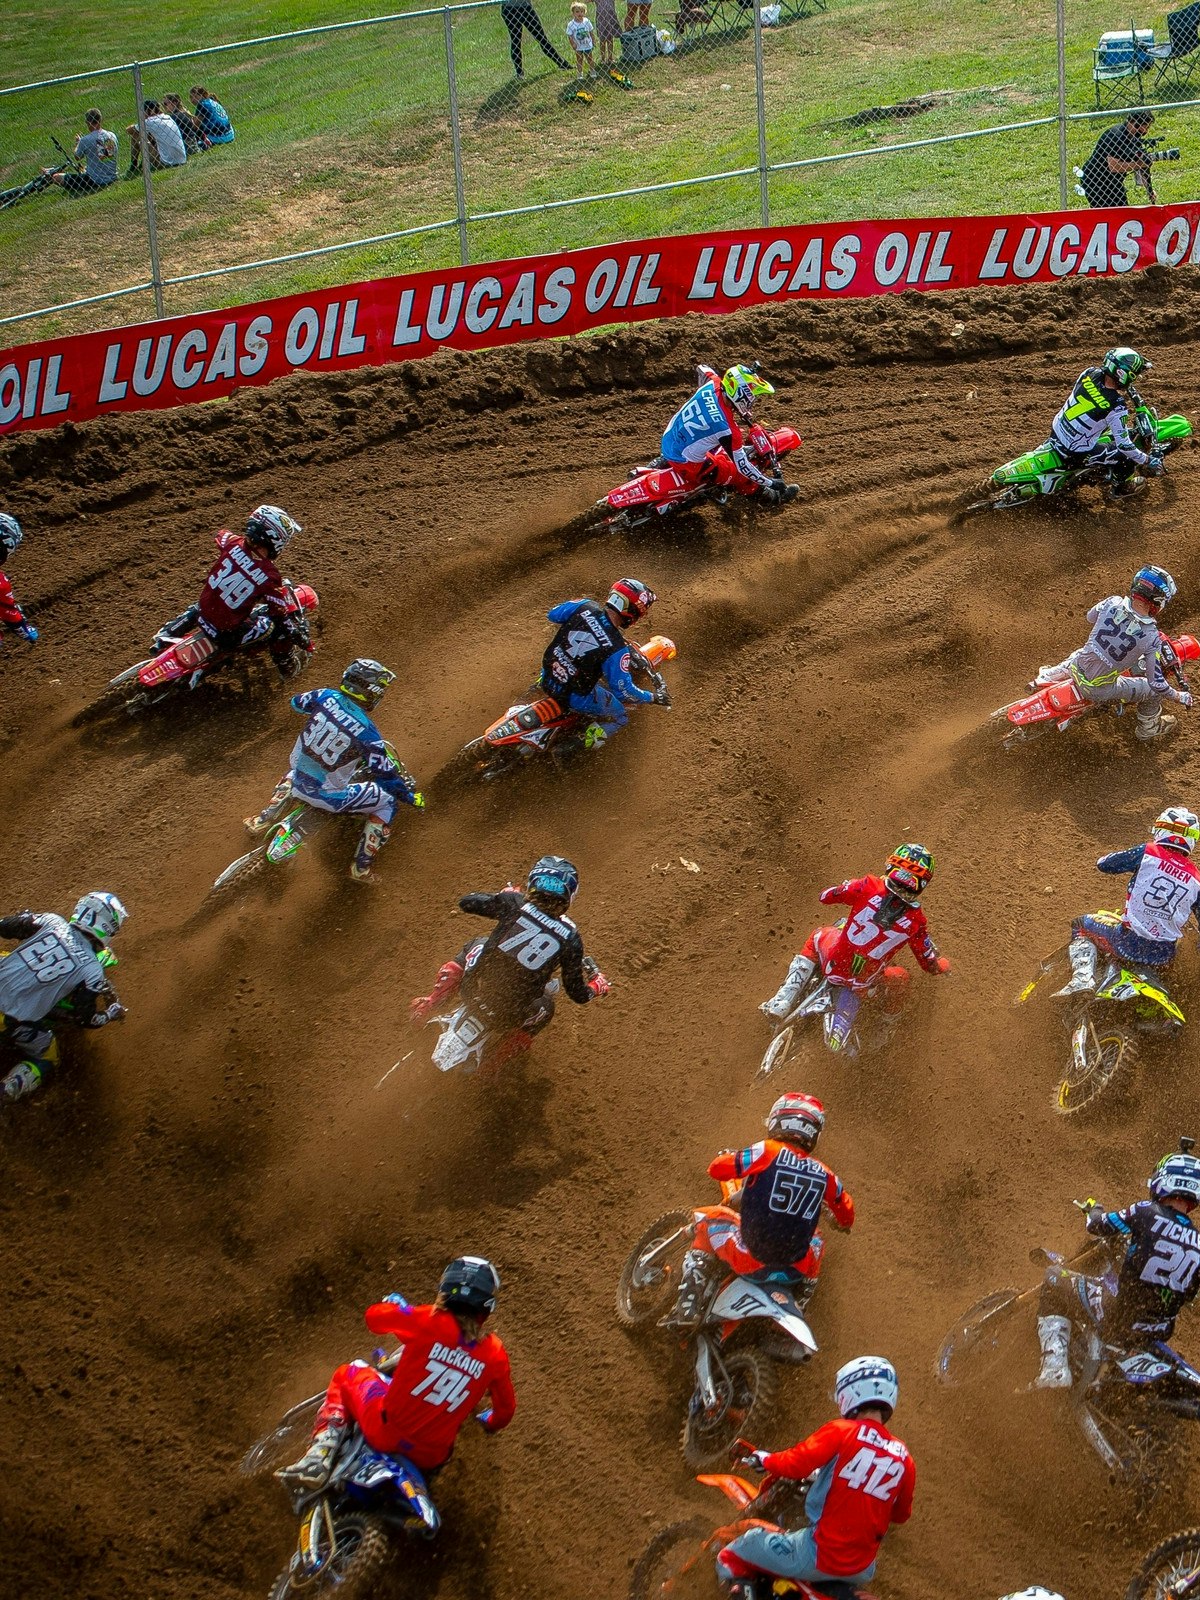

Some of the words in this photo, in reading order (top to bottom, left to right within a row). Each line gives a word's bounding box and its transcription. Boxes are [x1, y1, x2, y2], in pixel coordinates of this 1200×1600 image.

[687, 234, 861, 299] LUCAS
[873, 230, 954, 287] OIL
[978, 218, 1144, 279] LUCAS
[392, 266, 576, 347] LUCAS
[584, 252, 662, 314] OIL
[97, 314, 273, 404] LUCAS
[285, 298, 367, 366] OIL
[701, 389, 724, 424] CRAIG
[1064, 394, 1097, 422] 1
[1081, 375, 1110, 410] TOMAC
[681, 400, 711, 438] 62
[208, 558, 255, 610] 349
[229, 545, 269, 586] HARLAN
[565, 630, 600, 659] 4
[579, 609, 613, 649] BAGGETT
[1095, 616, 1137, 662] 23
[303, 711, 351, 766] 309
[323, 697, 366, 737] SMITH
[1142, 875, 1189, 915] 31
[1157, 859, 1191, 884] NOREN
[17, 932, 77, 984] 258
[497, 916, 561, 971] 78
[846, 906, 911, 961] 51
[768, 1170, 827, 1219] 577
[1140, 1240, 1200, 1293] 20
[427, 1341, 487, 1382] BACKAUS
[410, 1360, 473, 1414] 794
[839, 1446, 906, 1502] 412
